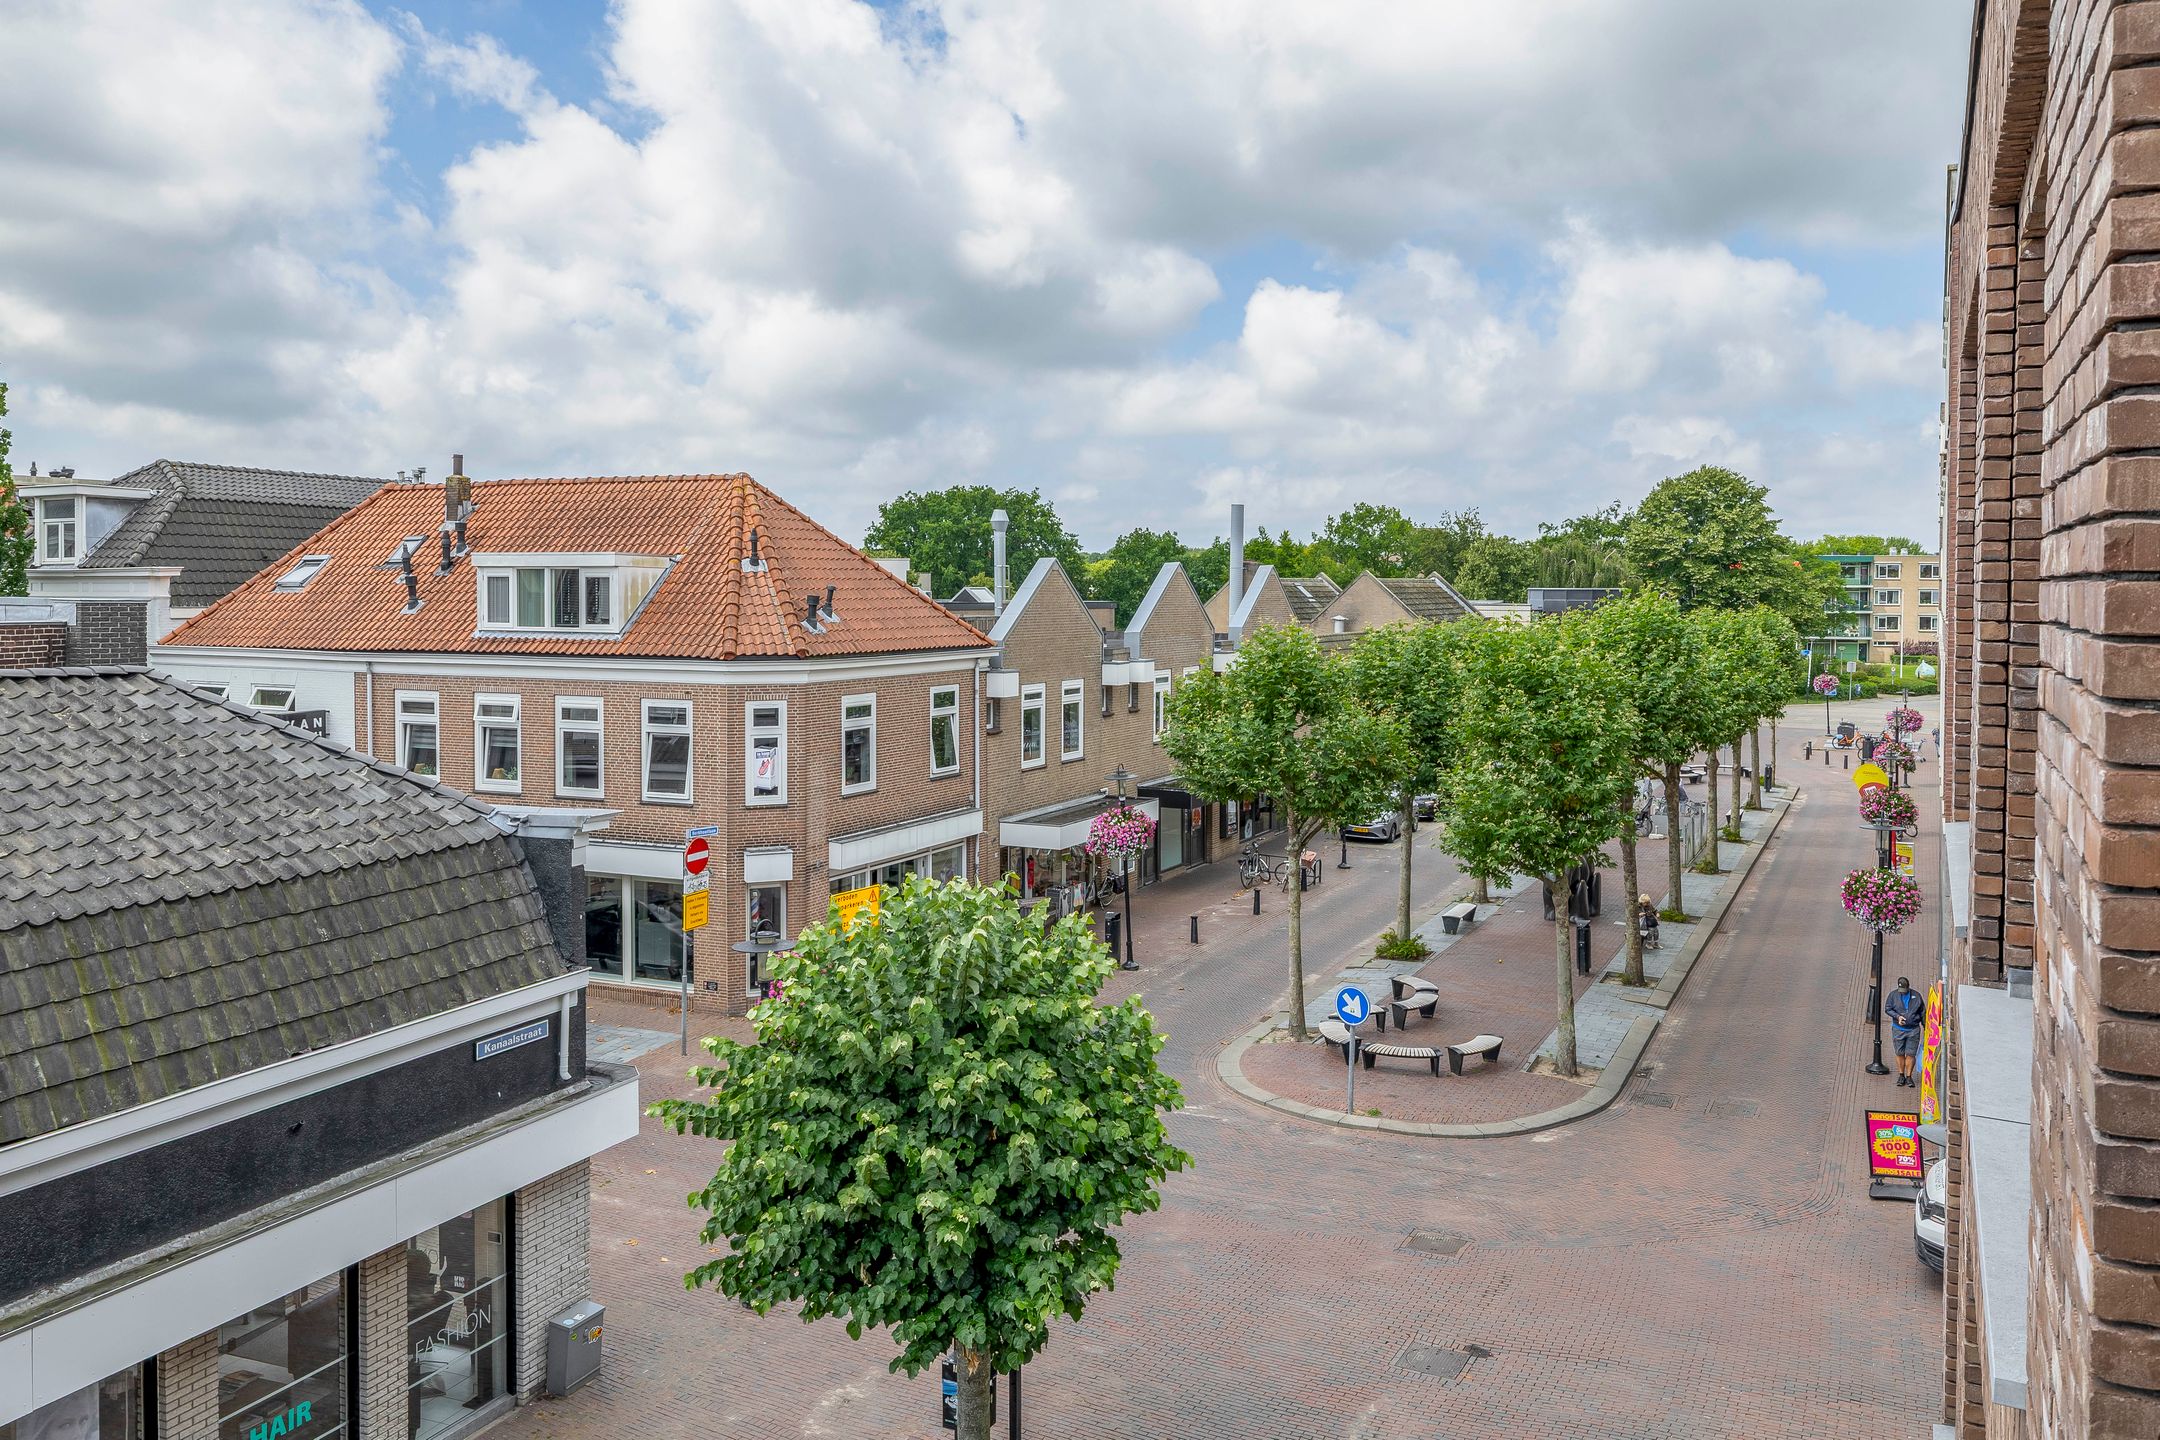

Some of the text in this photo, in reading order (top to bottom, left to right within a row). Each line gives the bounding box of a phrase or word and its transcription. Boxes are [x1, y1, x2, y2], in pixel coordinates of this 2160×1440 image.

[484, 1027, 542, 1053] Kanaalstraat
[1880, 1142, 1911, 1151] 1000
[415, 1304, 491, 1363] FASHION
[249, 1400, 312, 1440] HAIR
